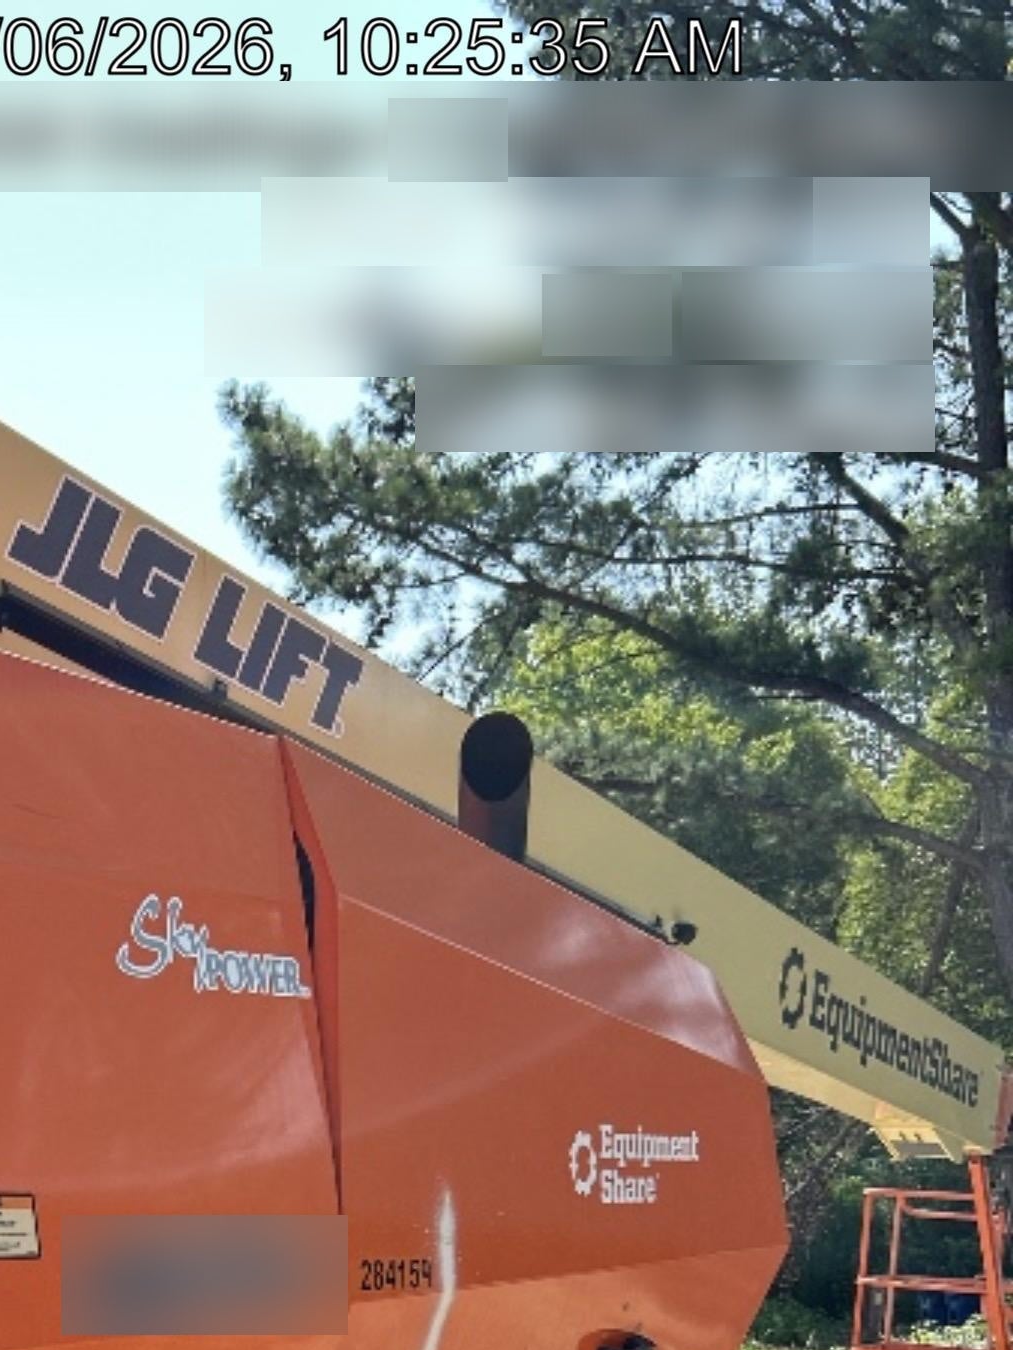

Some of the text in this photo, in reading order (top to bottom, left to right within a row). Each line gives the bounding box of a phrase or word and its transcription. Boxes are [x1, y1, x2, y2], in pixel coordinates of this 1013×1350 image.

[5, 474, 364, 738] JLG LIFT
[116, 893, 312, 998] Sky POWER
[809, 968, 979, 1108] EquipmentShare
[599, 1124, 699, 1168] Equipment
[600, 1169, 656, 1204] Share
